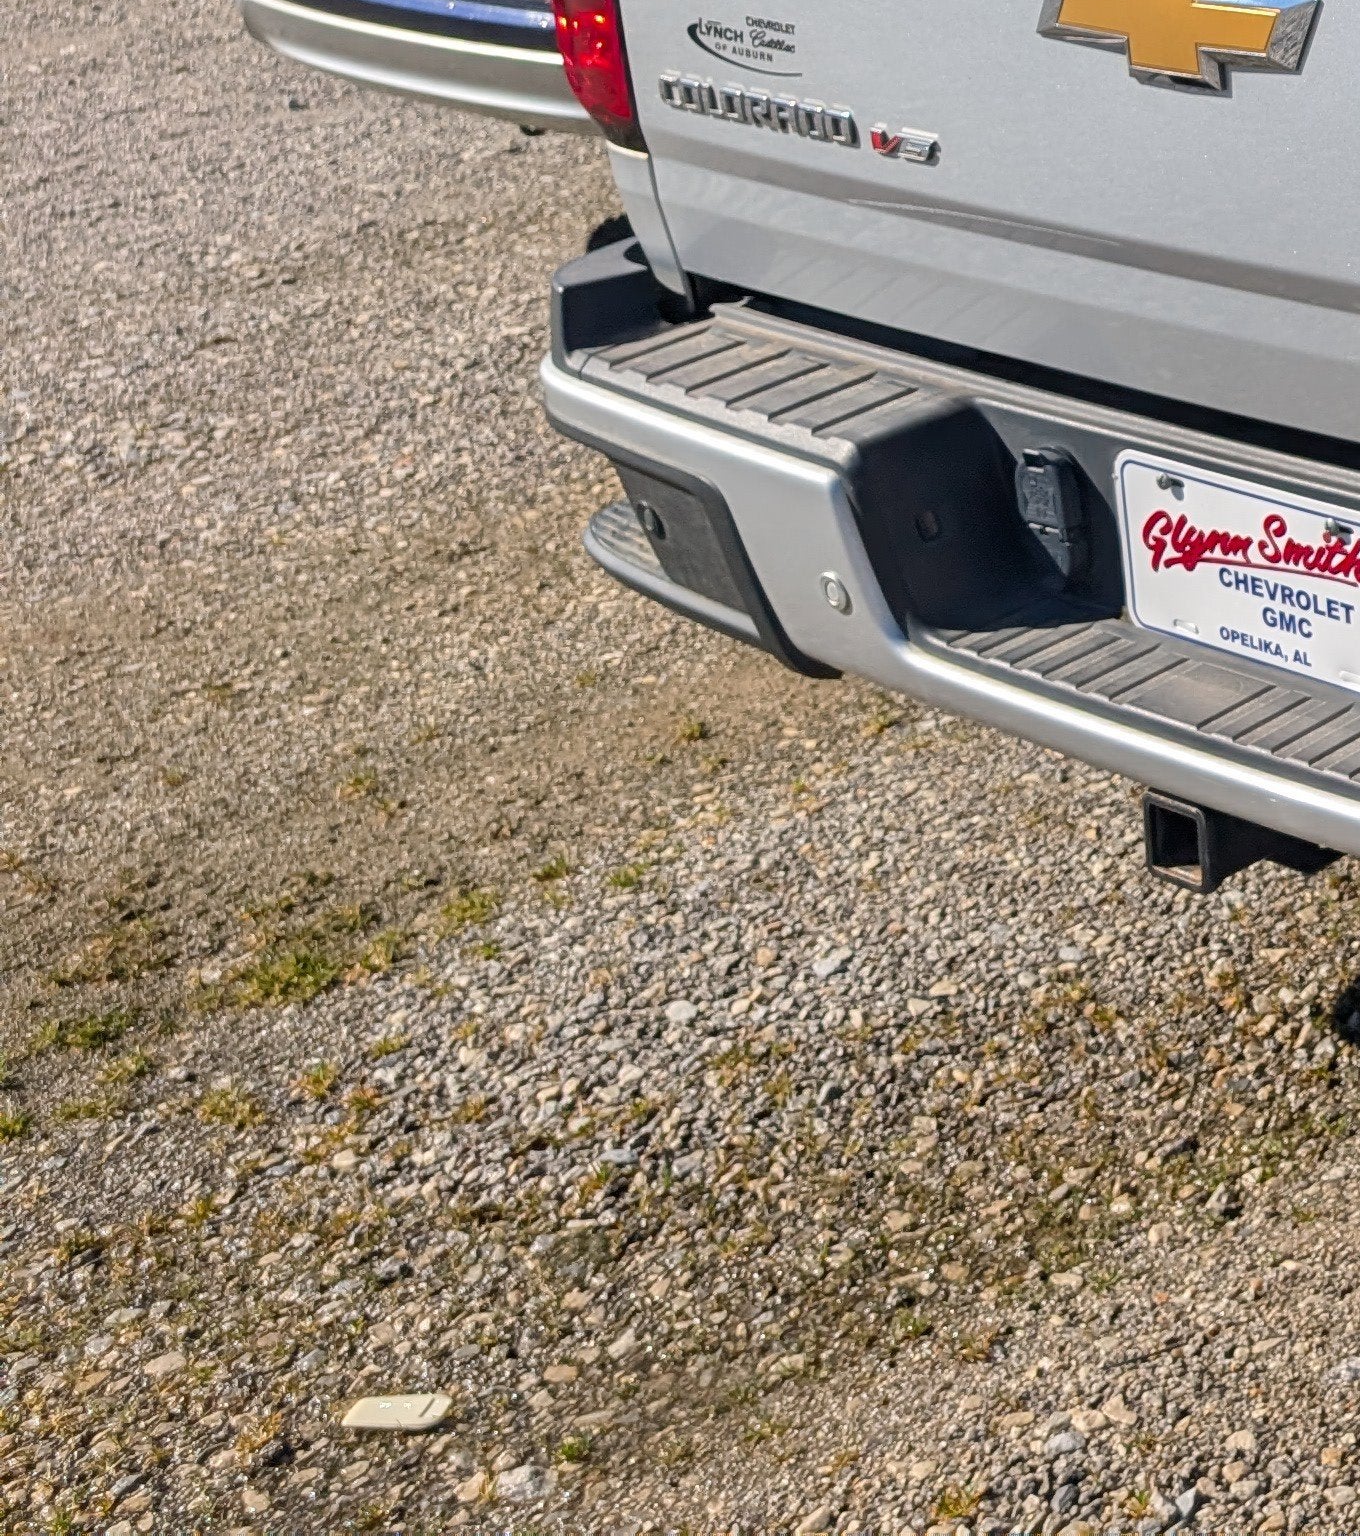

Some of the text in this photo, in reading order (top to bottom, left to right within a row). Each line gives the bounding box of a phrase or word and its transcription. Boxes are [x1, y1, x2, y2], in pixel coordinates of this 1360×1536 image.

[697, 16, 744, 44] LYNCH
[714, 41, 774, 63] OF AUBURN
[658, 70, 860, 148] COLORADO
[1142, 509, 1255, 573] Glynn
[1218, 566, 1356, 625] CHEVROLET
[1262, 606, 1314, 640] GMC
[1218, 625, 1313, 668] OPELIKA, AL
